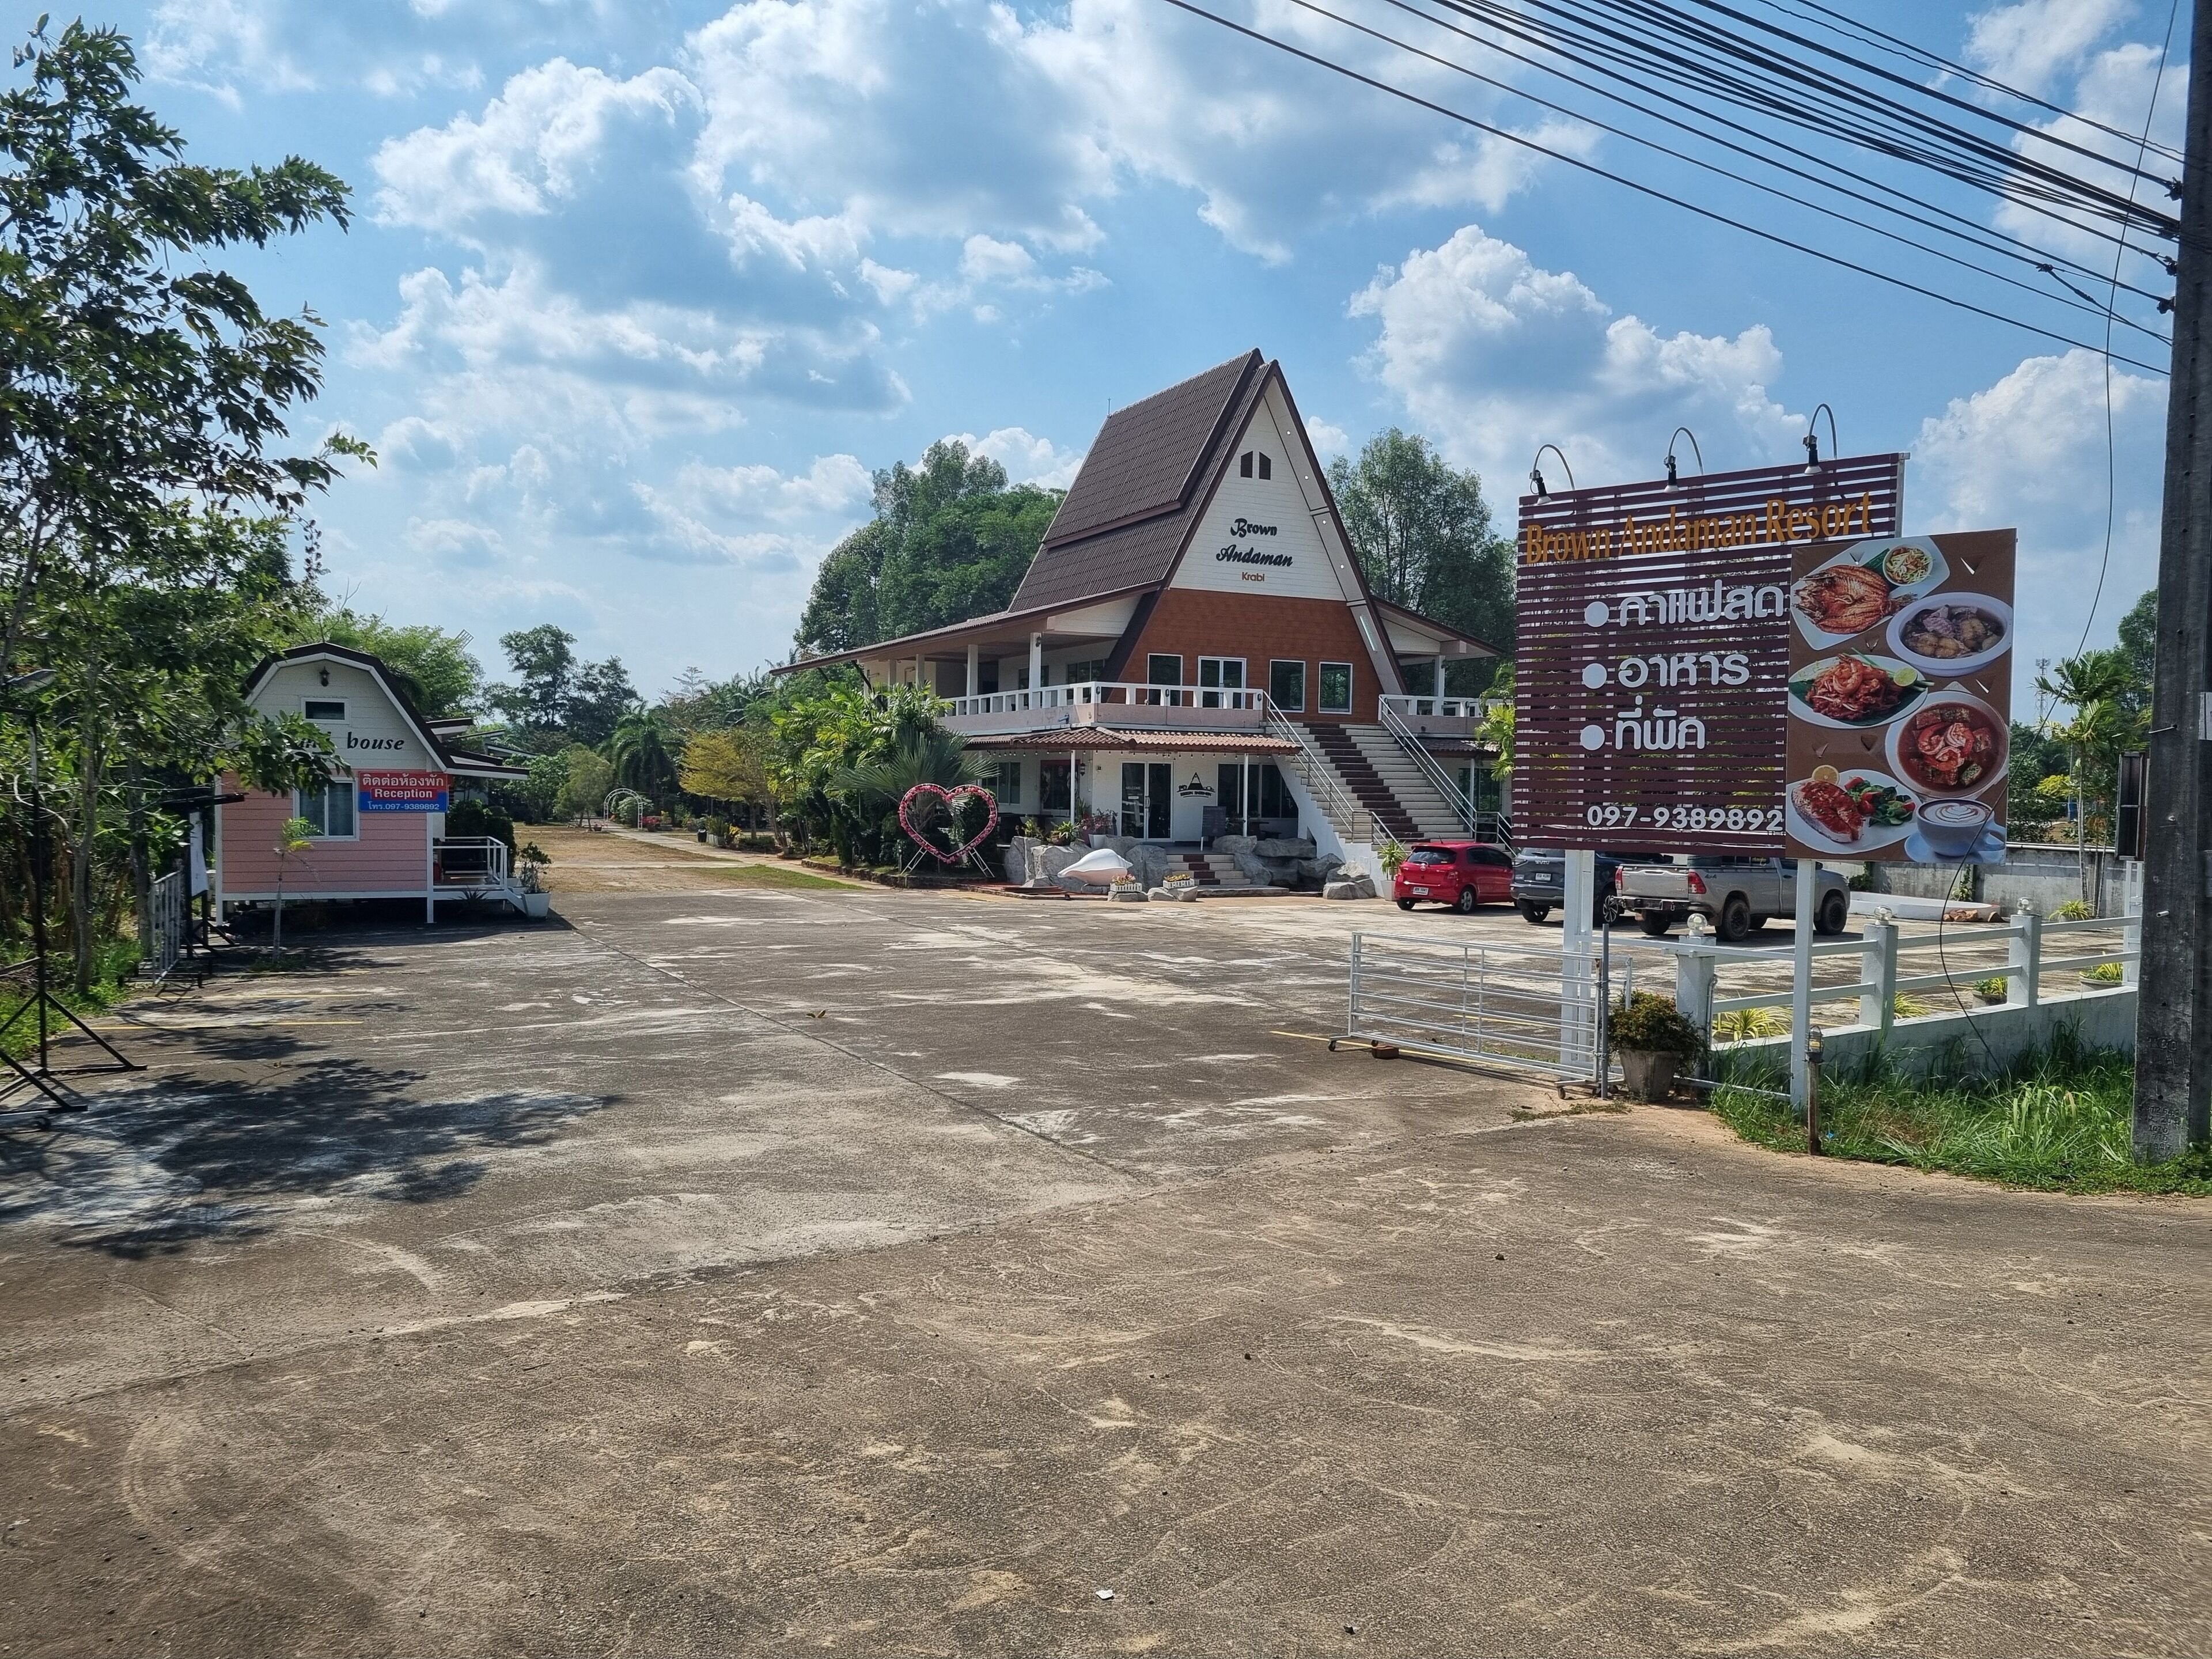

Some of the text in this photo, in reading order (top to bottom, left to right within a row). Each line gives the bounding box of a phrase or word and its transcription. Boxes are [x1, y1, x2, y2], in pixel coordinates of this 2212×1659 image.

[1230, 518, 1277, 538] Brown
[1527, 490, 1872, 563] Brown Andaman Resort
[1216, 544, 1293, 567] Andaman
[1241, 571, 1265, 582] Krabi
[1620, 579, 1784, 627] กาแฟสด
[1618, 654, 1749, 688] อาหาร
[1615, 695, 1705, 750] ที่พัก
[362, 773, 444, 786] ติดต่อห้องพัก
[374, 789, 433, 800] Reception
[1587, 806, 1783, 831] 097-9389892
